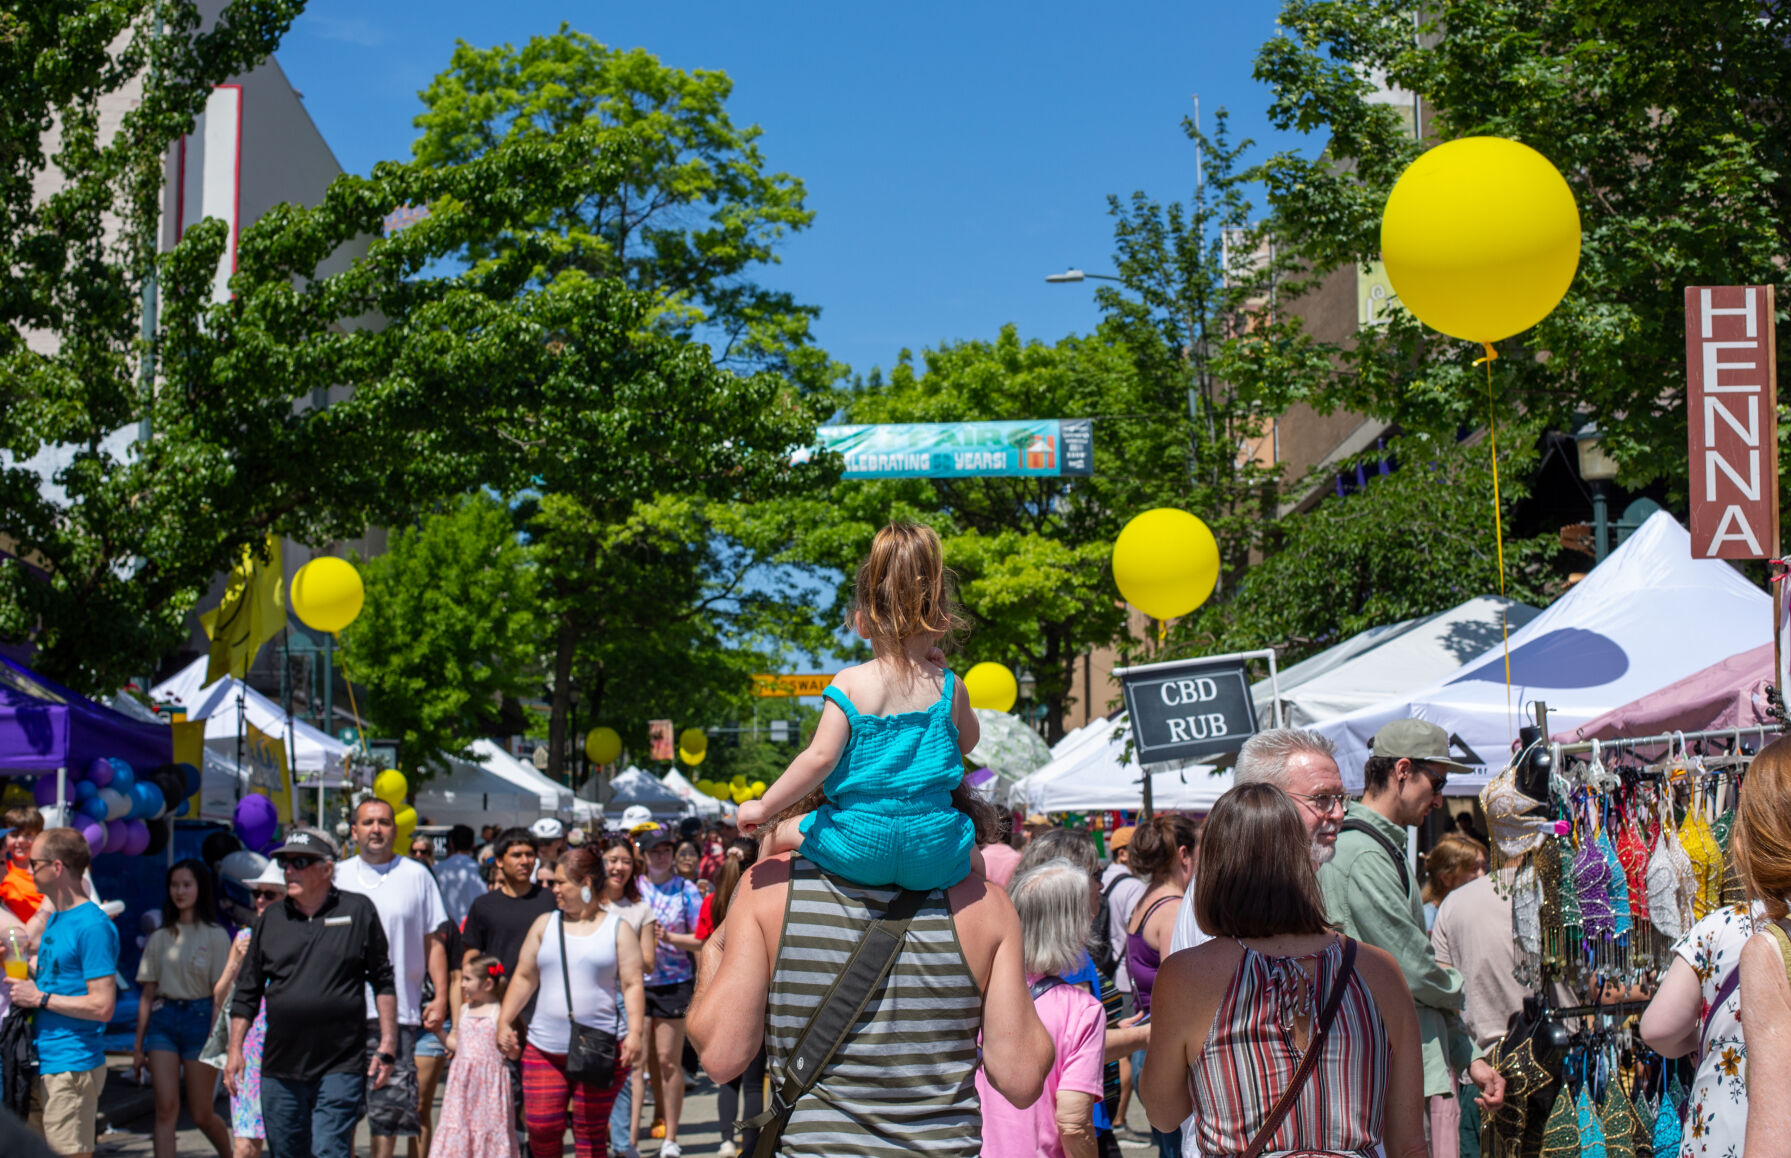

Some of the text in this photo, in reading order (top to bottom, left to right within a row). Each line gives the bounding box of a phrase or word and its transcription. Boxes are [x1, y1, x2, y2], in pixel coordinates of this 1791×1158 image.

[1700, 287, 1764, 557] HENNA
[954, 451, 1007, 470] YEARS!
[1160, 677, 1218, 706] CBD
[1166, 713, 1228, 743] RUB
